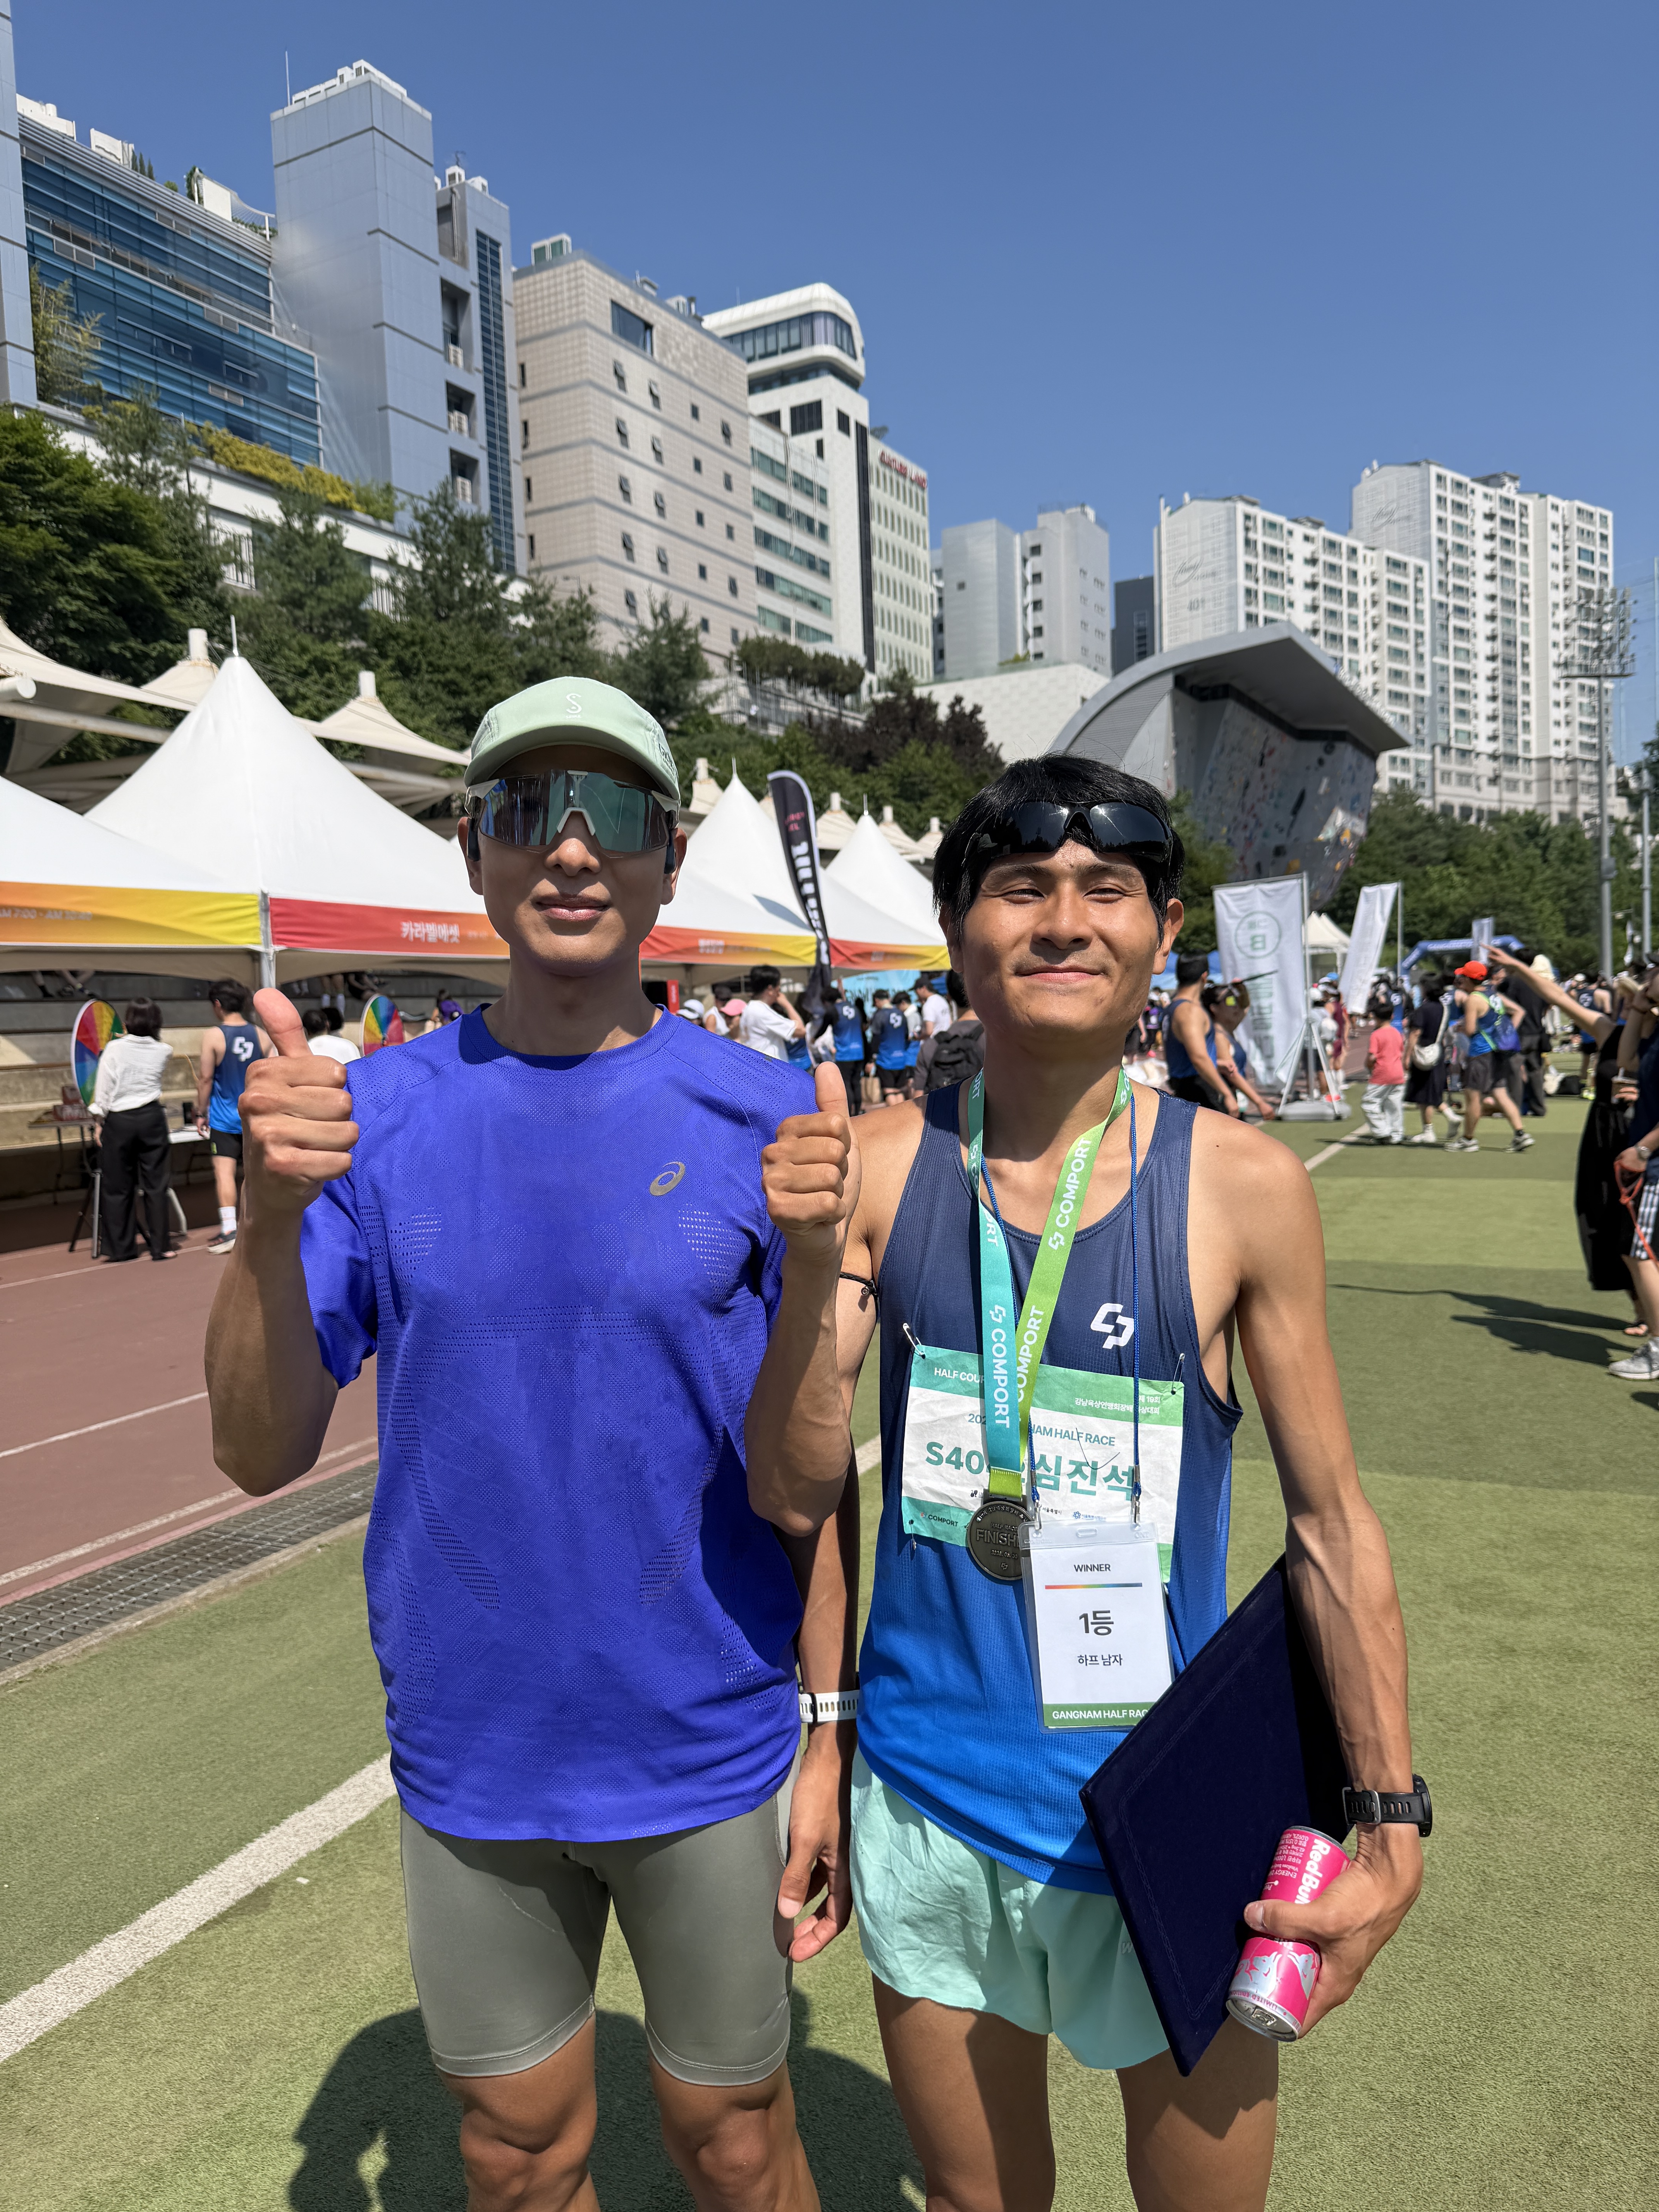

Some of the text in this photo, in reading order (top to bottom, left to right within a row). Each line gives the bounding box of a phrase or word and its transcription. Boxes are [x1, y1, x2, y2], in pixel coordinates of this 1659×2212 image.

[1056, 1137, 1092, 1228] COMPORT
[934, 1367, 959, 1379] HALF
[992, 1328, 1009, 1428] COMPORT
[968, 1413, 986, 1425] 202
[1055, 1429, 1083, 1441] HALF
[1085, 1433, 1115, 1446] RACE
[1036, 1454, 1134, 1501] 심진석
[928, 1515, 958, 1527] COMPORT
[1074, 1563, 1111, 1572] WINNER
[1079, 1610, 1114, 1635] 1등
[1078, 1654, 1123, 1666] 하프 남자
[1052, 1710, 1102, 1719] GANGNAM
[1104, 1710, 1128, 1718] HALF
[1274, 1870, 1297, 1878] ENERGY
[1252, 1994, 1278, 2011] LIMITED
